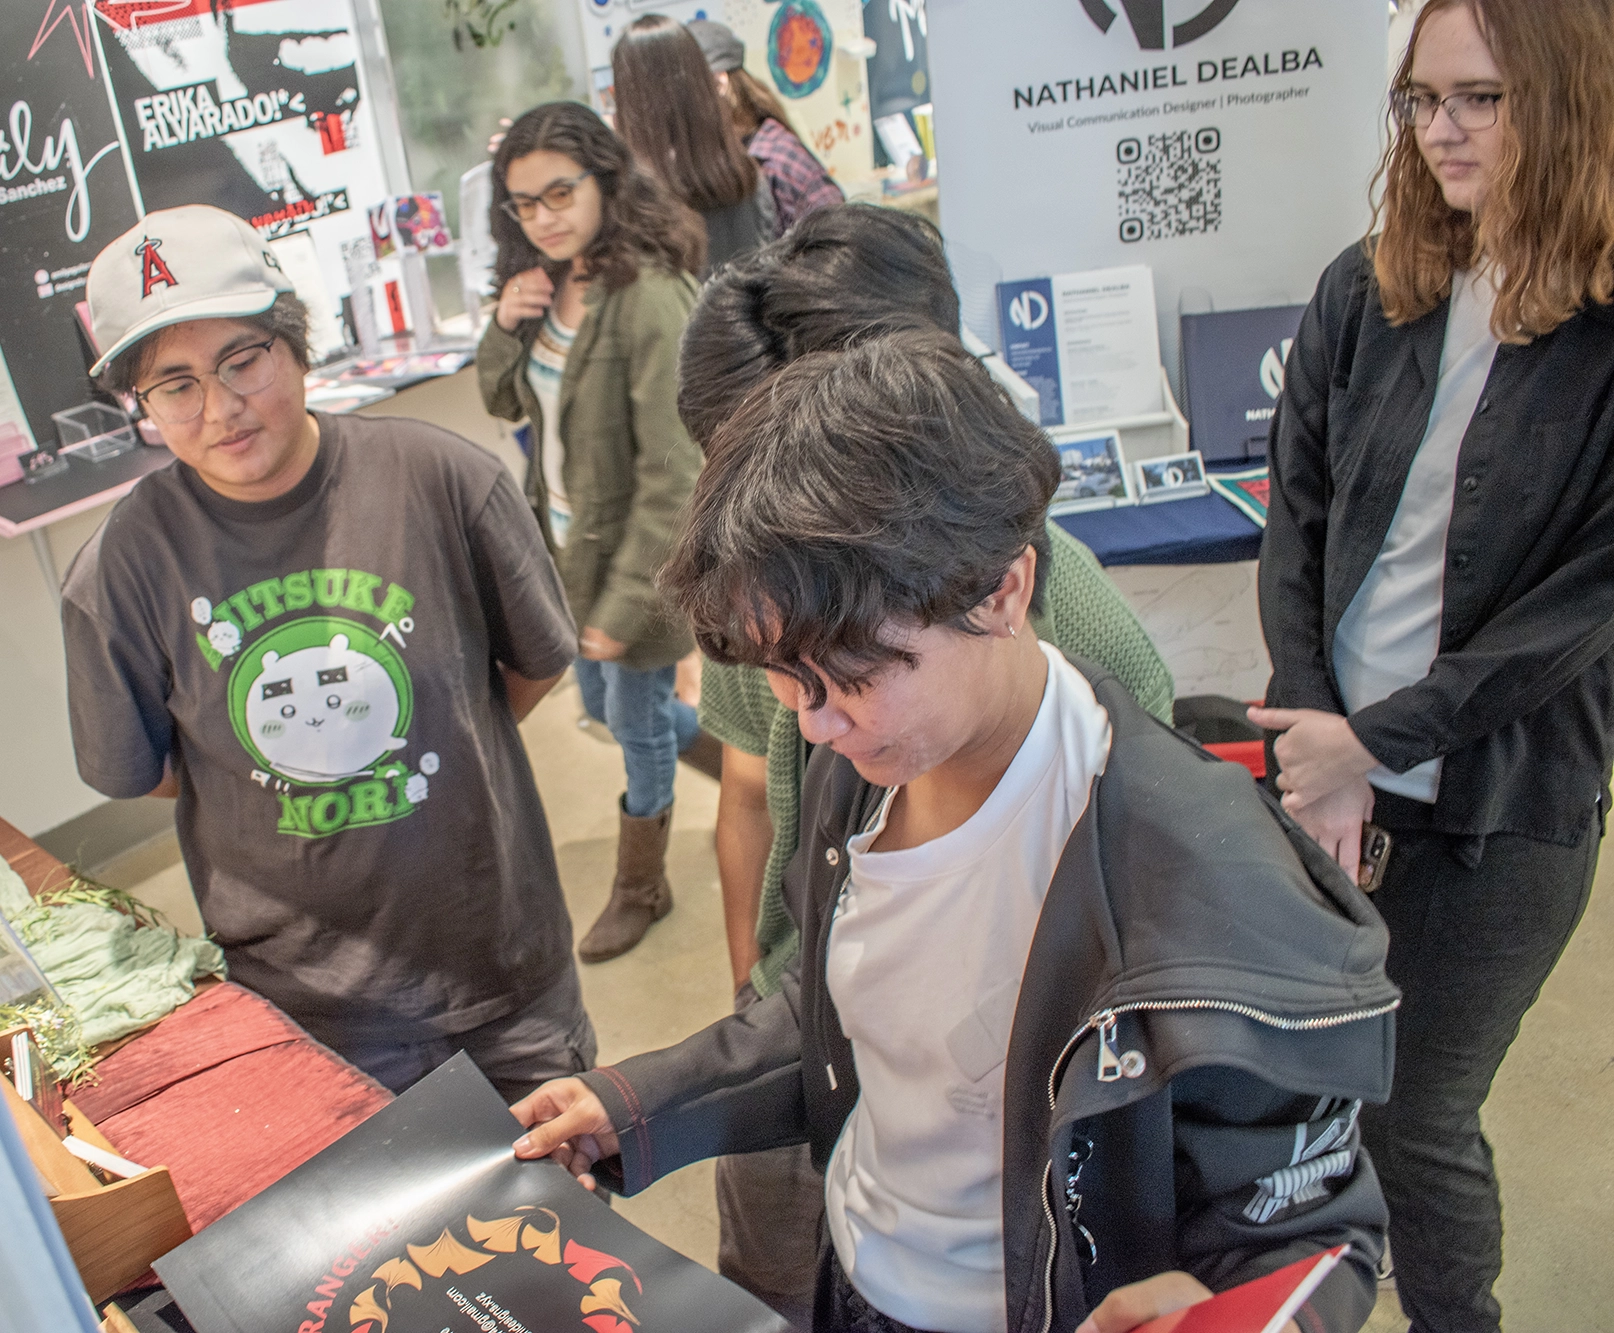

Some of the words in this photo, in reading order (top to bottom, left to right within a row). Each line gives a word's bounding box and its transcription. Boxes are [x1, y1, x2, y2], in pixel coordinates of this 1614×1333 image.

[1013, 65, 1187, 110] NATHANIEL
[1197, 47, 1324, 84] DEALBA
[134, 84, 216, 130] ERIKA
[1028, 118, 1064, 134] Visual
[1067, 105, 1160, 128] Communication
[1163, 98, 1216, 115] Designer
[1227, 86, 1310, 106] Photographer
[0, 175, 67, 205] Sanchez
[446, 1286, 506, 1333] 4@gmail.com
